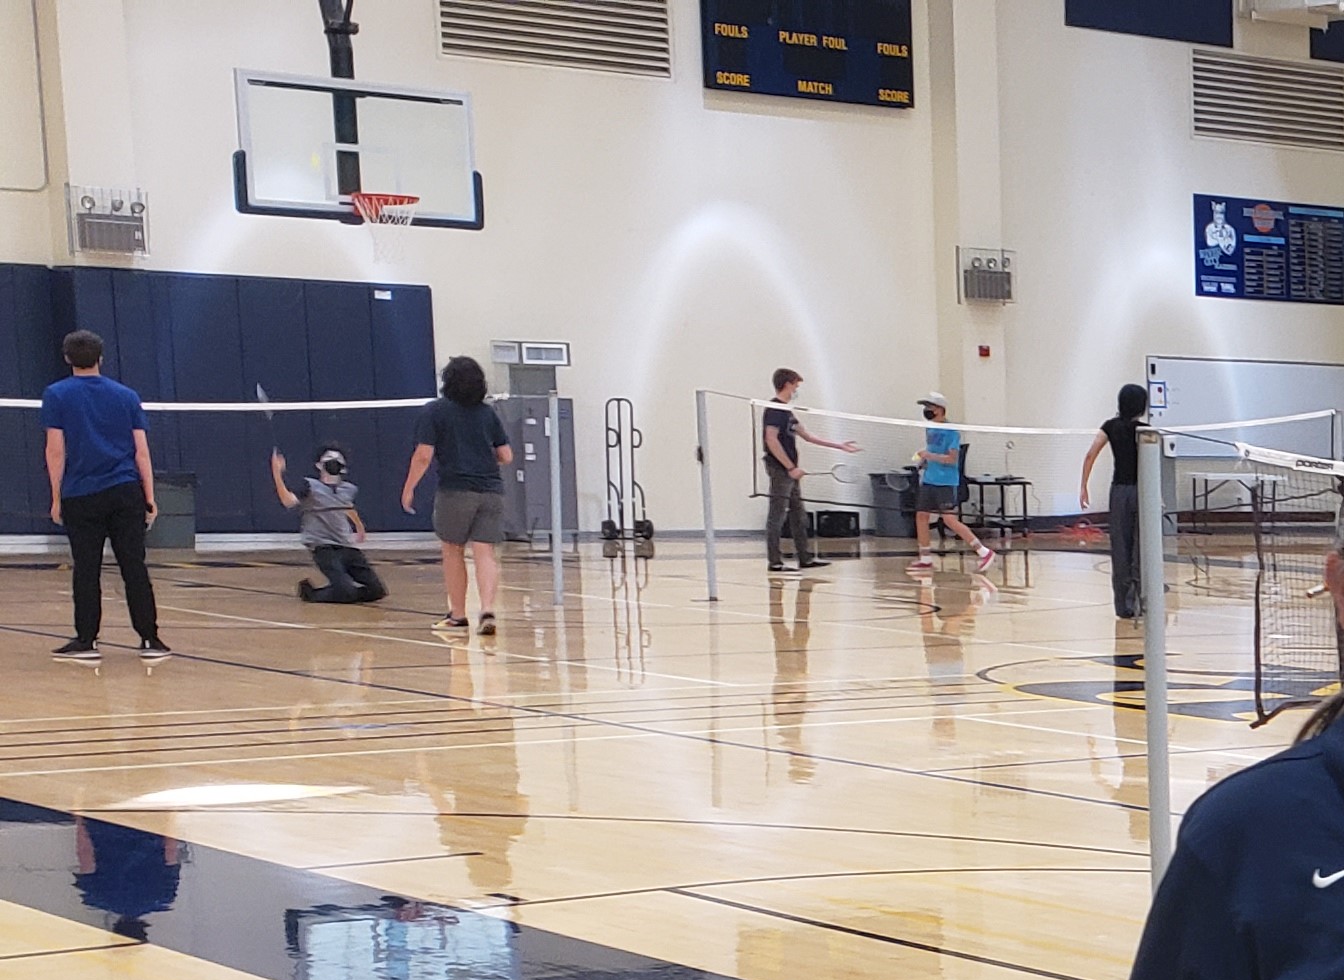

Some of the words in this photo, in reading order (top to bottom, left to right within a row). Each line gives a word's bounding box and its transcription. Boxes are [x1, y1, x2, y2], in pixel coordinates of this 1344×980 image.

[714, 23, 748, 39] FOULS
[778, 30, 817, 47] PLAYER
[822, 35, 848, 51] FOUL
[877, 42, 908, 57] FOULS
[716, 71, 751, 87] SCORE
[797, 80, 833, 95] MATCH
[878, 89, 910, 103] SCORE
